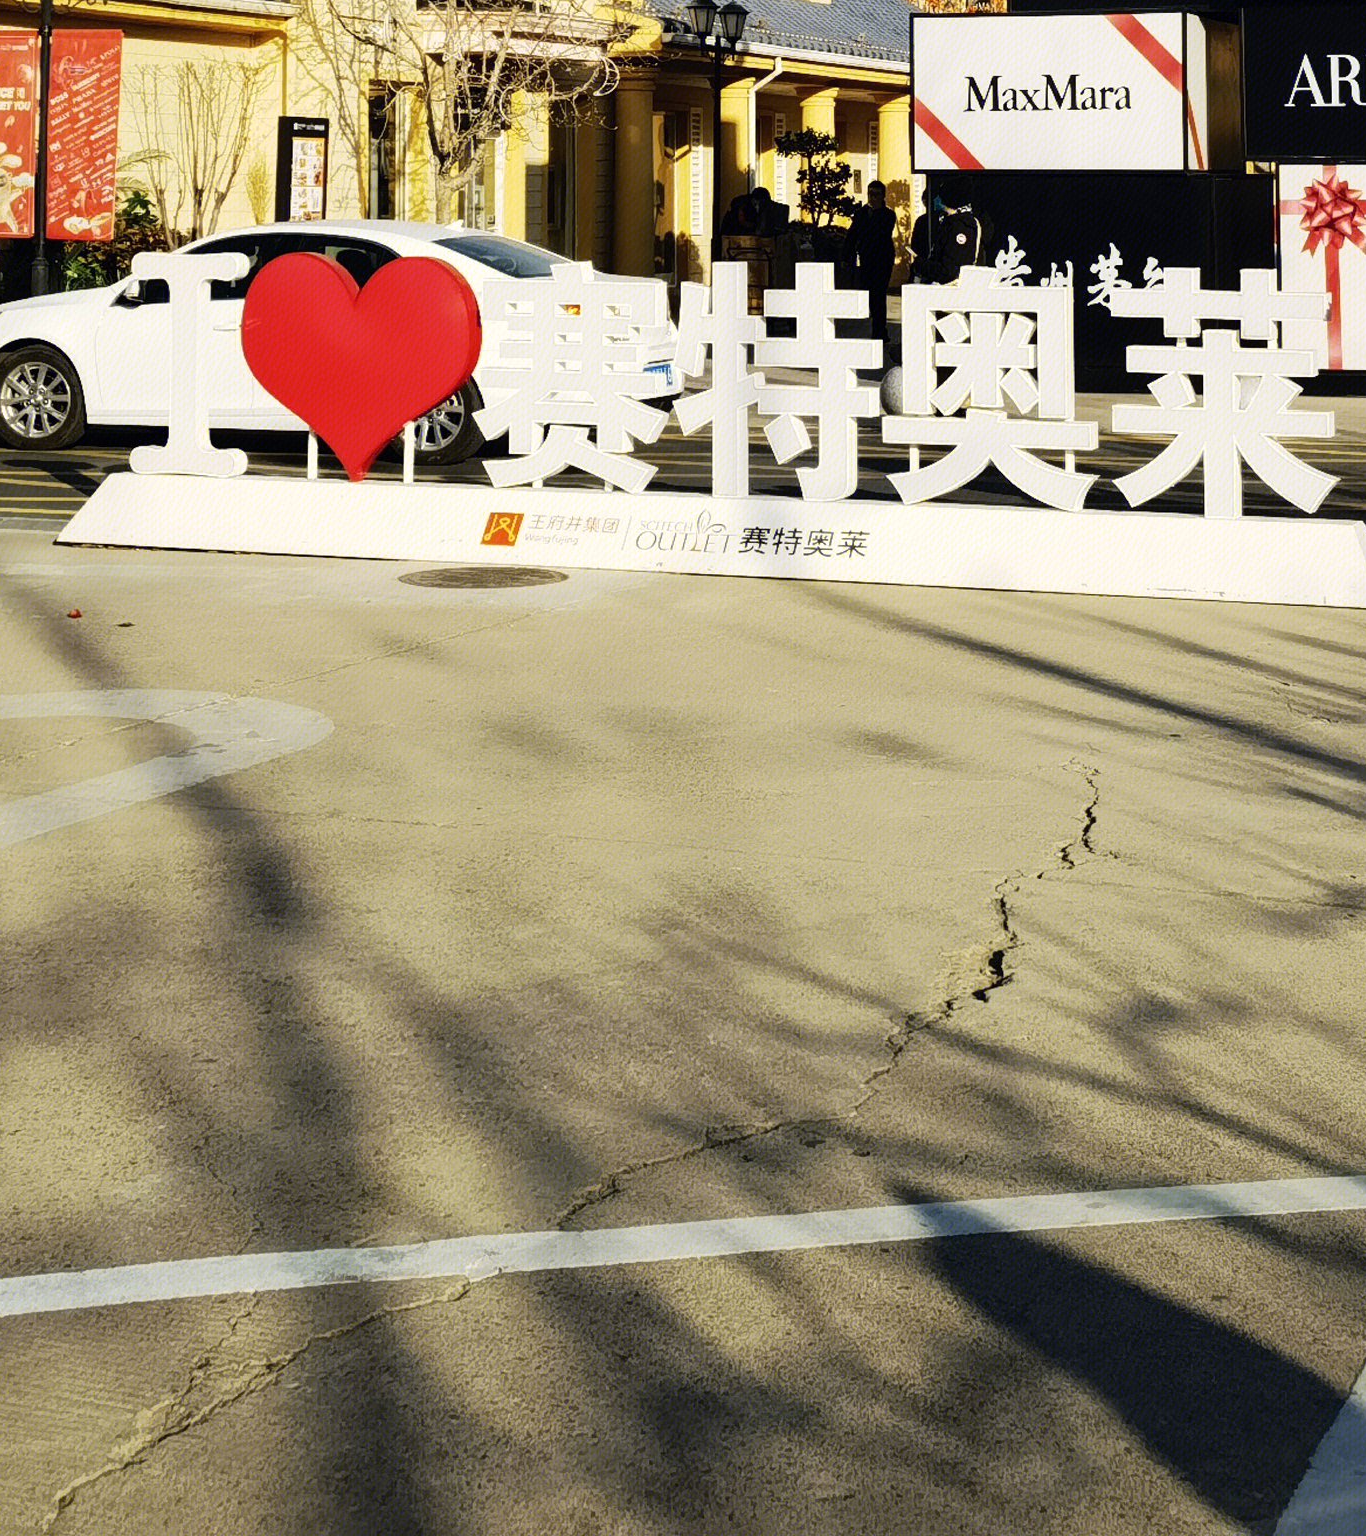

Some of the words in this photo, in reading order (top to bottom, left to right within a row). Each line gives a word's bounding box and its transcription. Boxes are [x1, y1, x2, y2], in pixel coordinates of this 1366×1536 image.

[13, 100, 32, 112] YOU
[963, 75, 1132, 113] MaxMara
[129, 250, 249, 479] I
[472, 261, 1341, 520] 赛特奥莱
[527, 513, 620, 534] 王府井集团
[639, 519, 694, 532] SCITECH
[635, 529, 737, 555] OUTLET
[738, 526, 870, 559] 赛特奥莱
